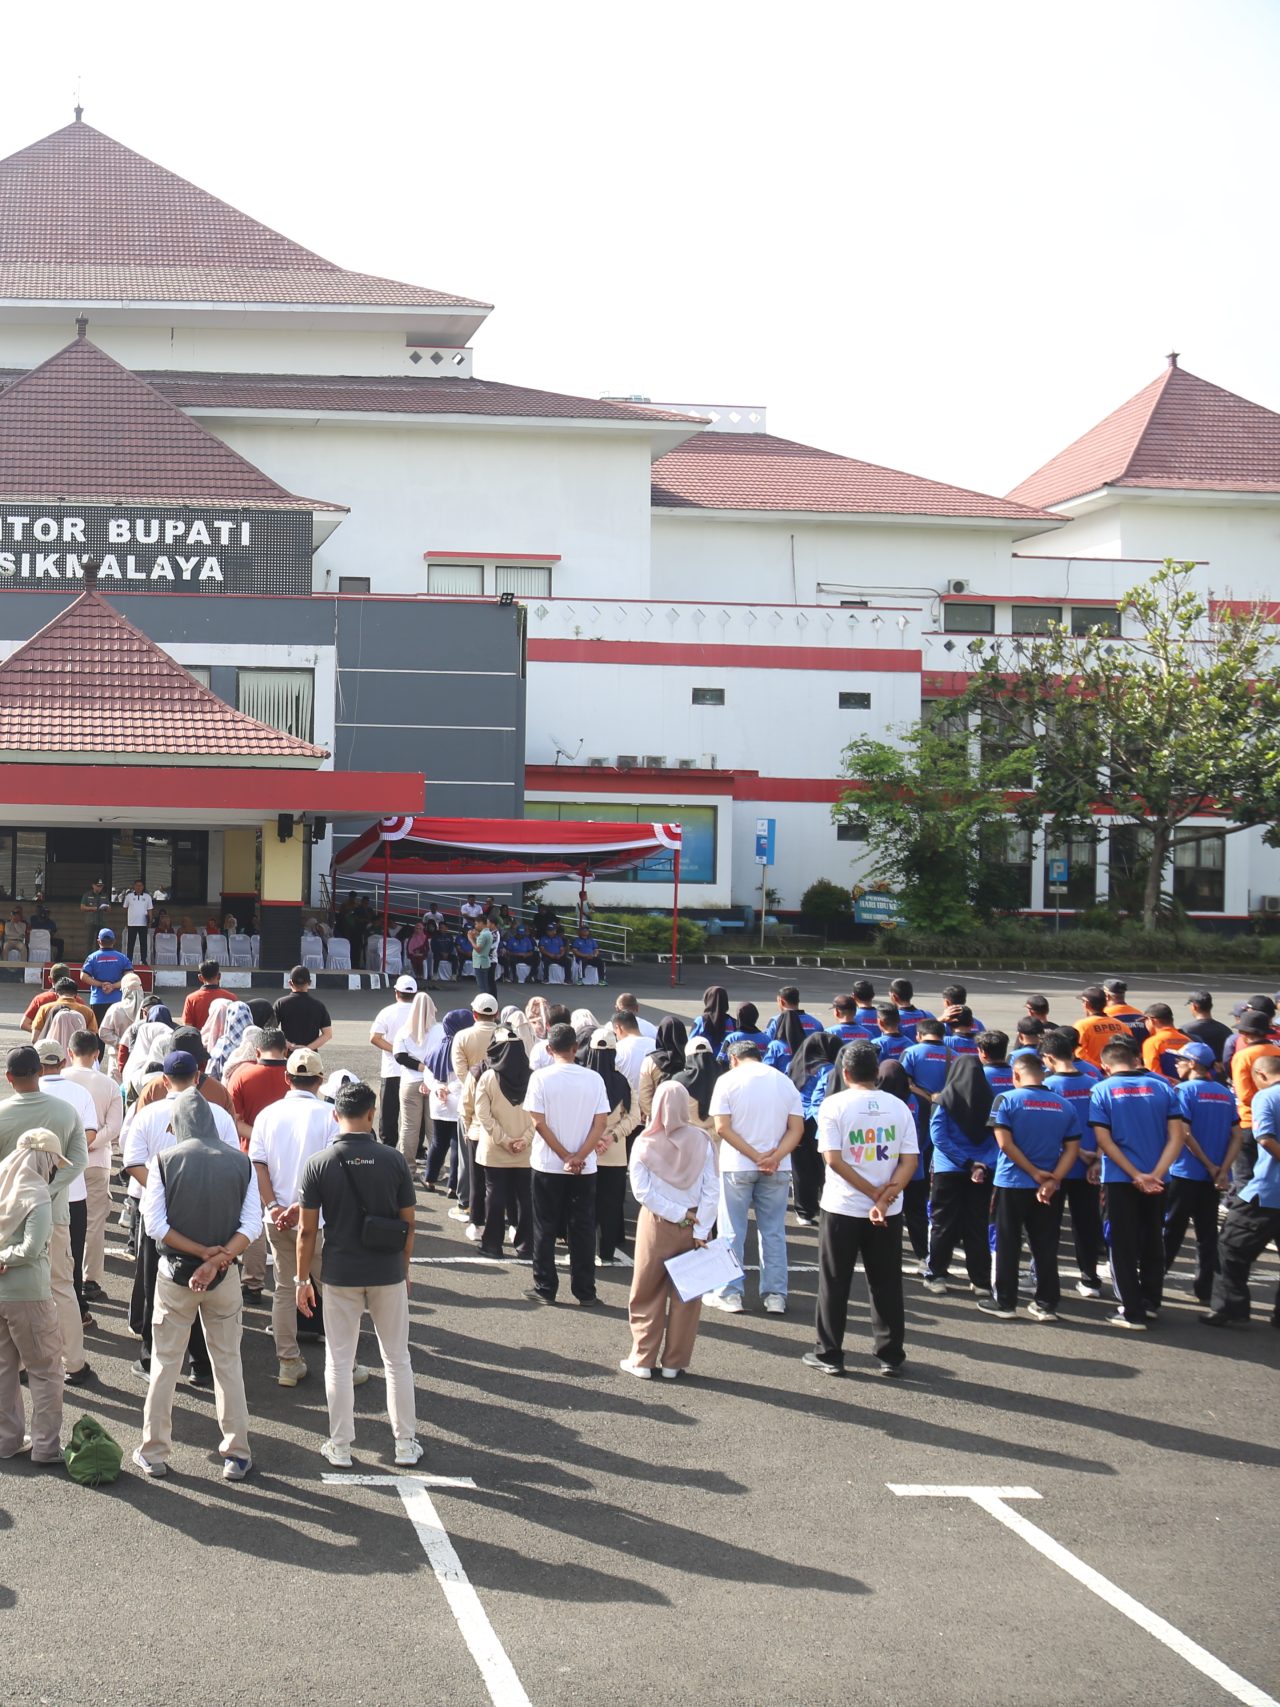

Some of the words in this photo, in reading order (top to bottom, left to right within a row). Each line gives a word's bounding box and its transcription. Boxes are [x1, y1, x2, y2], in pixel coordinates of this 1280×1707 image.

[108, 518, 250, 546] BUPATI
[1094, 1023, 1121, 1033] BPBD
[849, 1125, 896, 1145] MAIN
[849, 1144, 890, 1164] YUK
